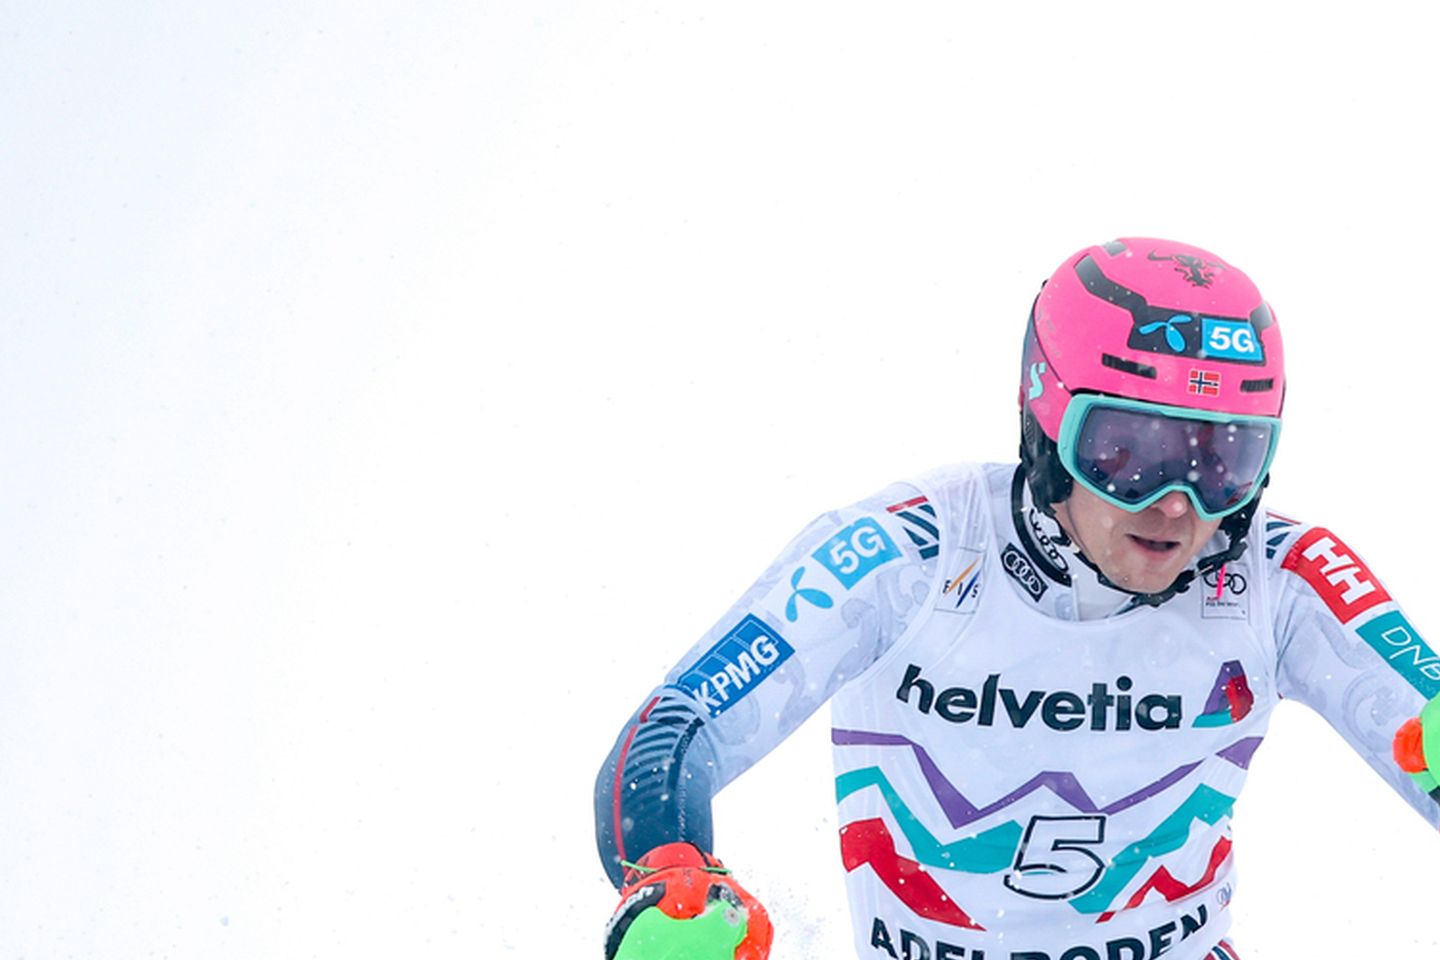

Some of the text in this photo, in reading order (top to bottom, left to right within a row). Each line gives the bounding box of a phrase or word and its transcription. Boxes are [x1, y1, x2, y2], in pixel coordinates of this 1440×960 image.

[1208, 326, 1255, 353] 5G
[829, 524, 886, 576] 5G
[692, 634, 780, 714] KPMG
[896, 663, 1182, 731] helvetia
[1003, 814, 1107, 901] 5
